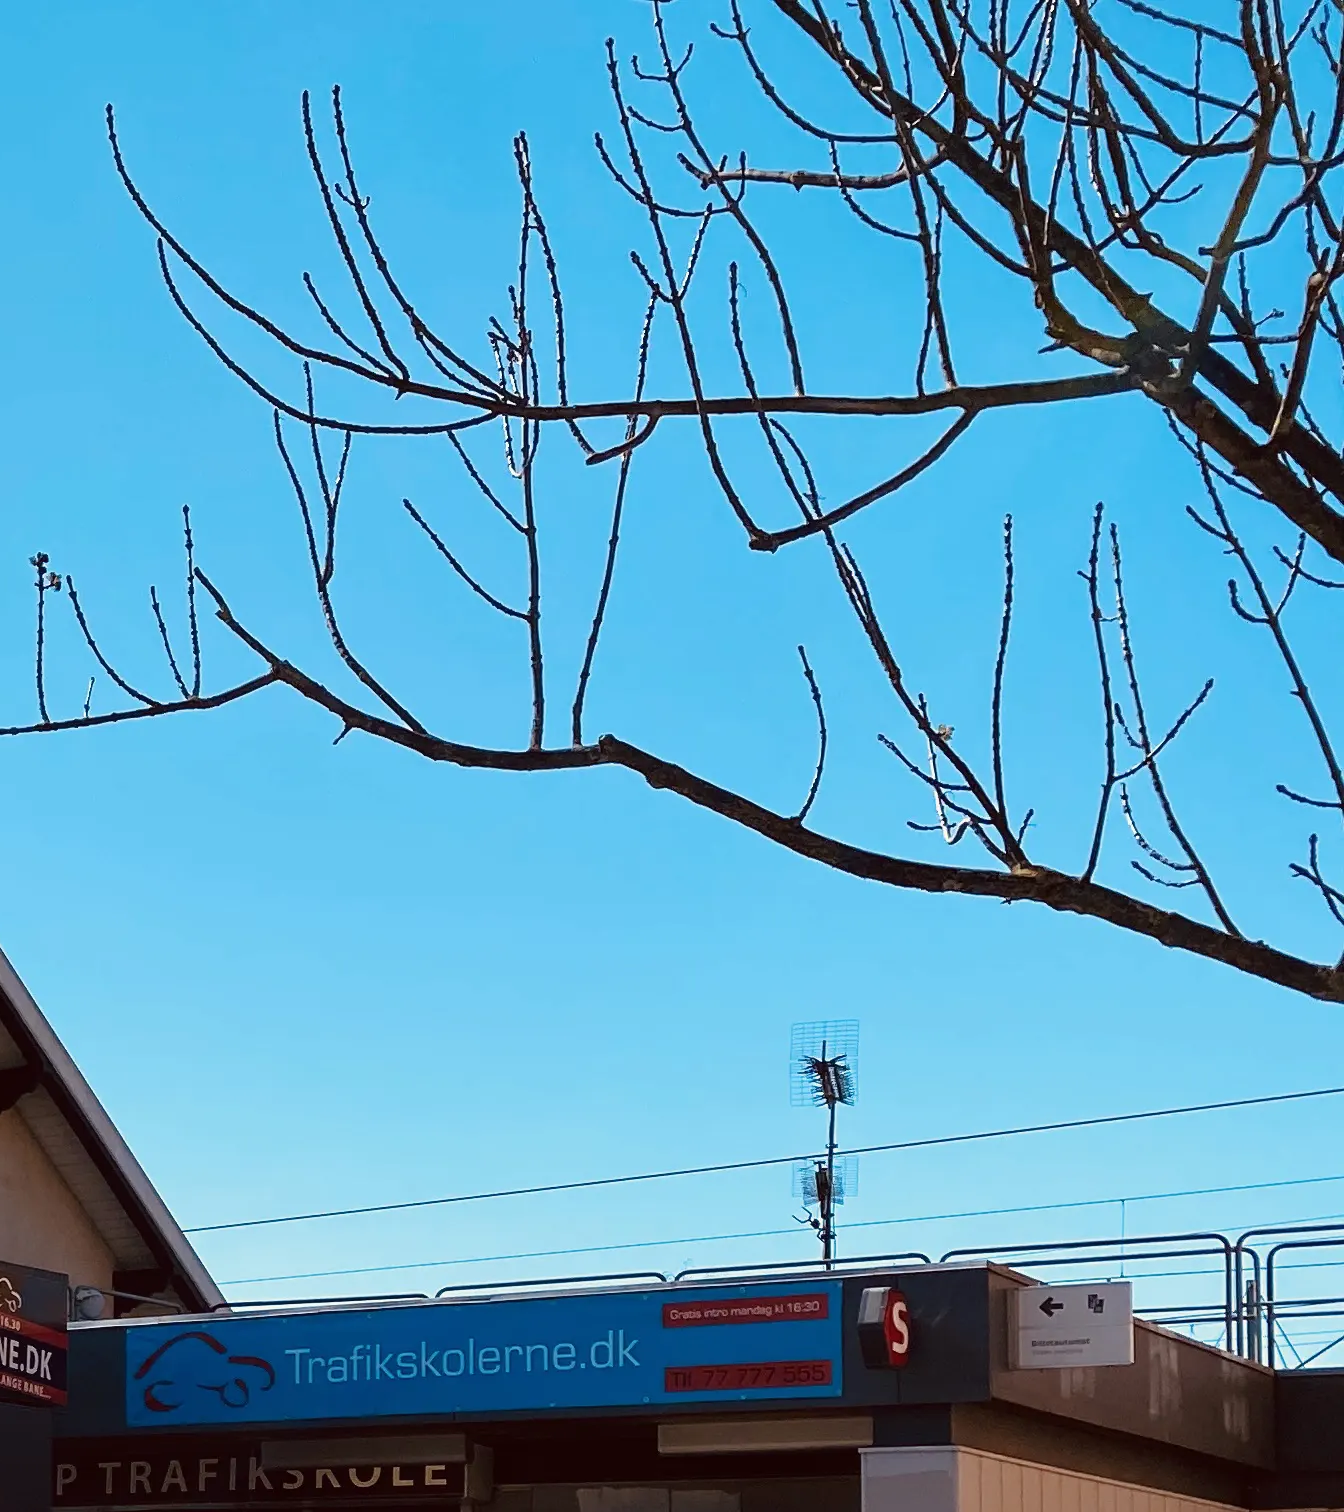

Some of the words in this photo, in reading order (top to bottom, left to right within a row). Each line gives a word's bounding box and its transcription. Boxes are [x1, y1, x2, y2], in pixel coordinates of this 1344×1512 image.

[0, 1313, 21, 1331] 16.30
[670, 1309, 702, 1320] Gratis
[704, 1308, 729, 1318] intro
[730, 1305, 773, 1317] mandag
[775, 1303, 784, 1313] kl
[892, 1301, 909, 1355] S
[284, 1329, 641, 1385] Trafikskolerne.dk
[703, 1369, 728, 1387] 77
[738, 1366, 776, 1385] 777
[783, 1364, 825, 1383] 555
[98, 1456, 447, 1494] TRAFIKSKOLE
